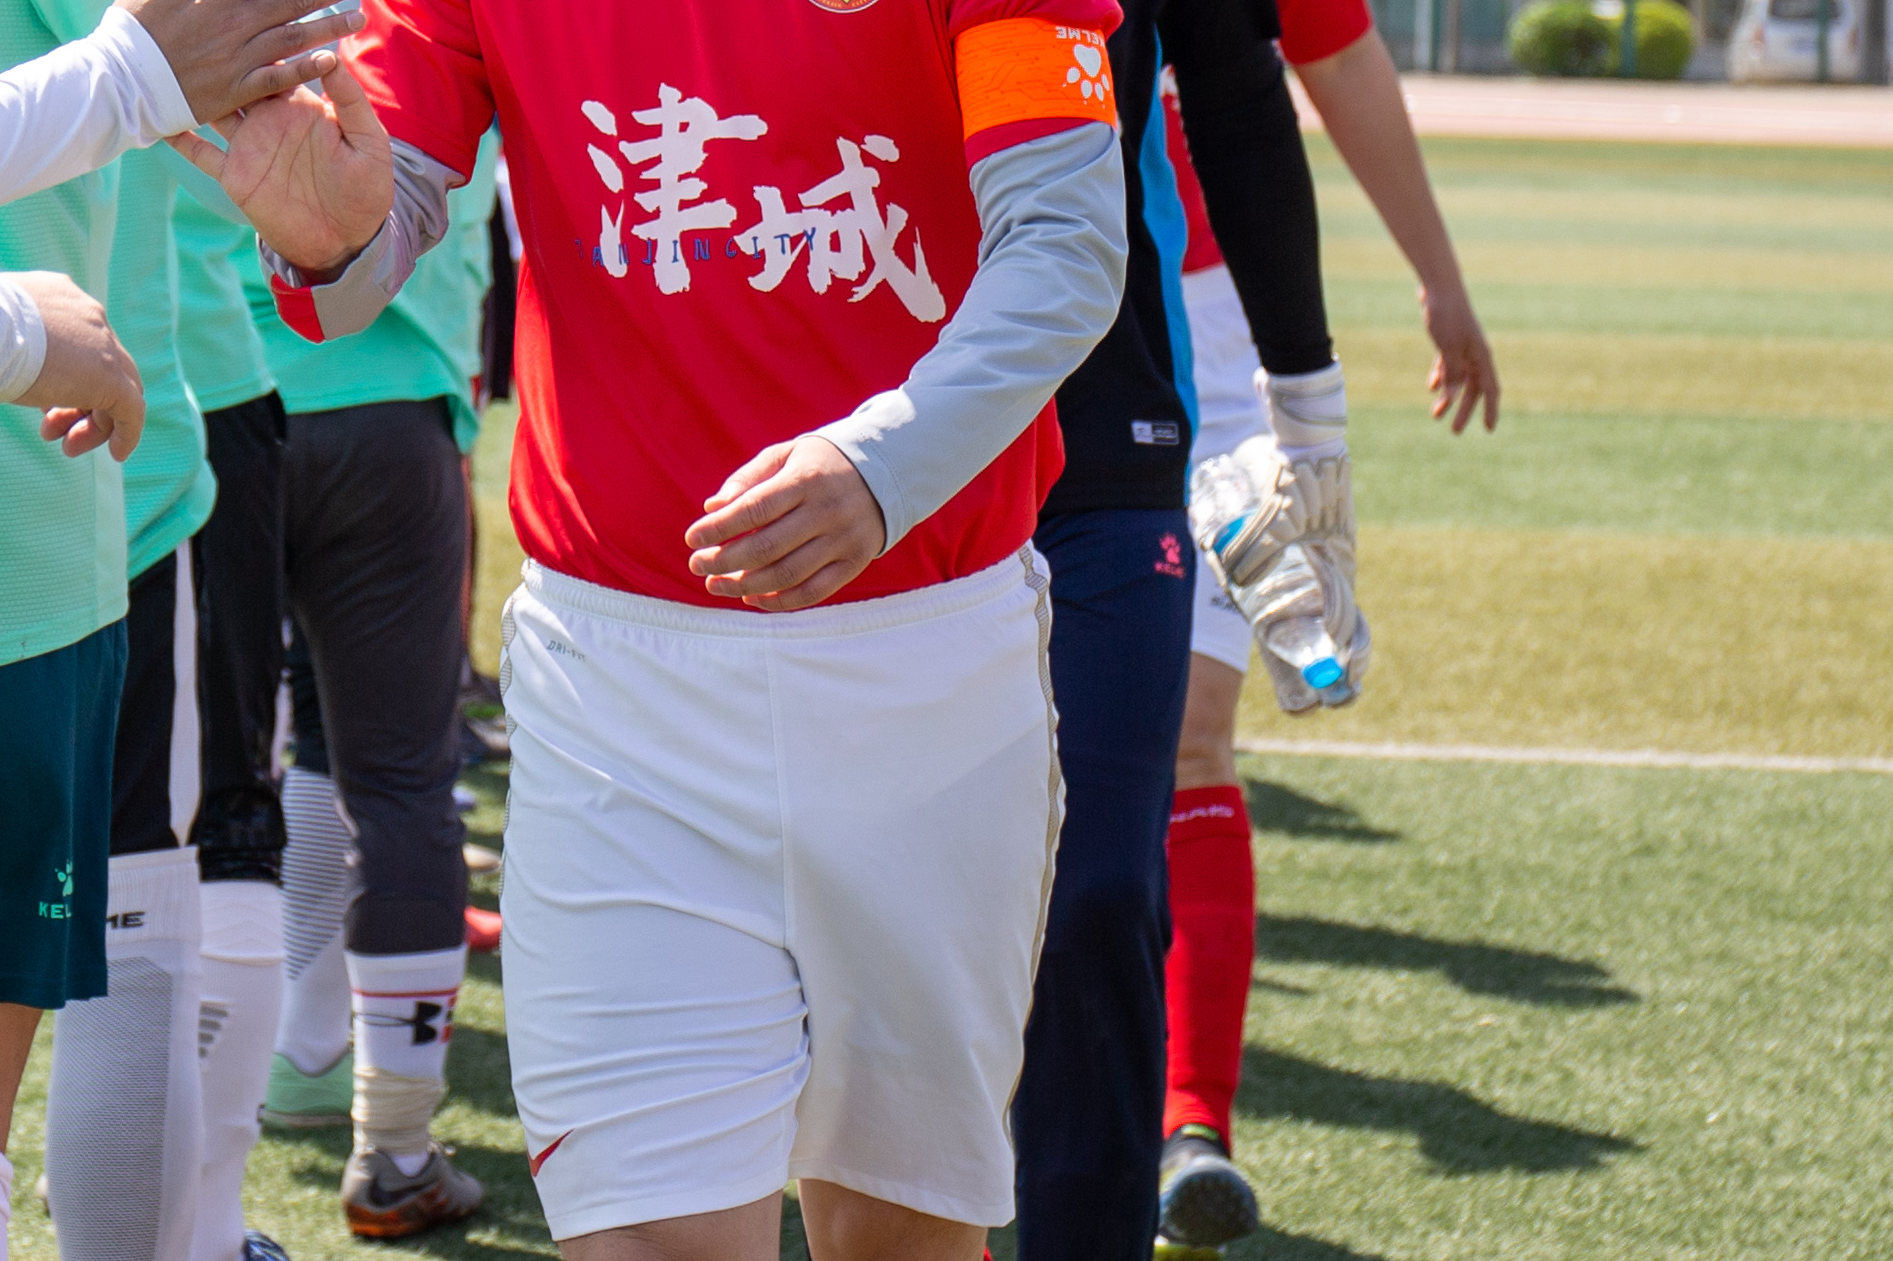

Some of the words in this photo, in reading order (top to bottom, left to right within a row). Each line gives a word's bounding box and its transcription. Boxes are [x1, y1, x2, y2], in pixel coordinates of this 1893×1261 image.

[581, 82, 947, 323] 津城
[724, 227, 816, 260] CITY
[38, 901, 73, 919] KEL
